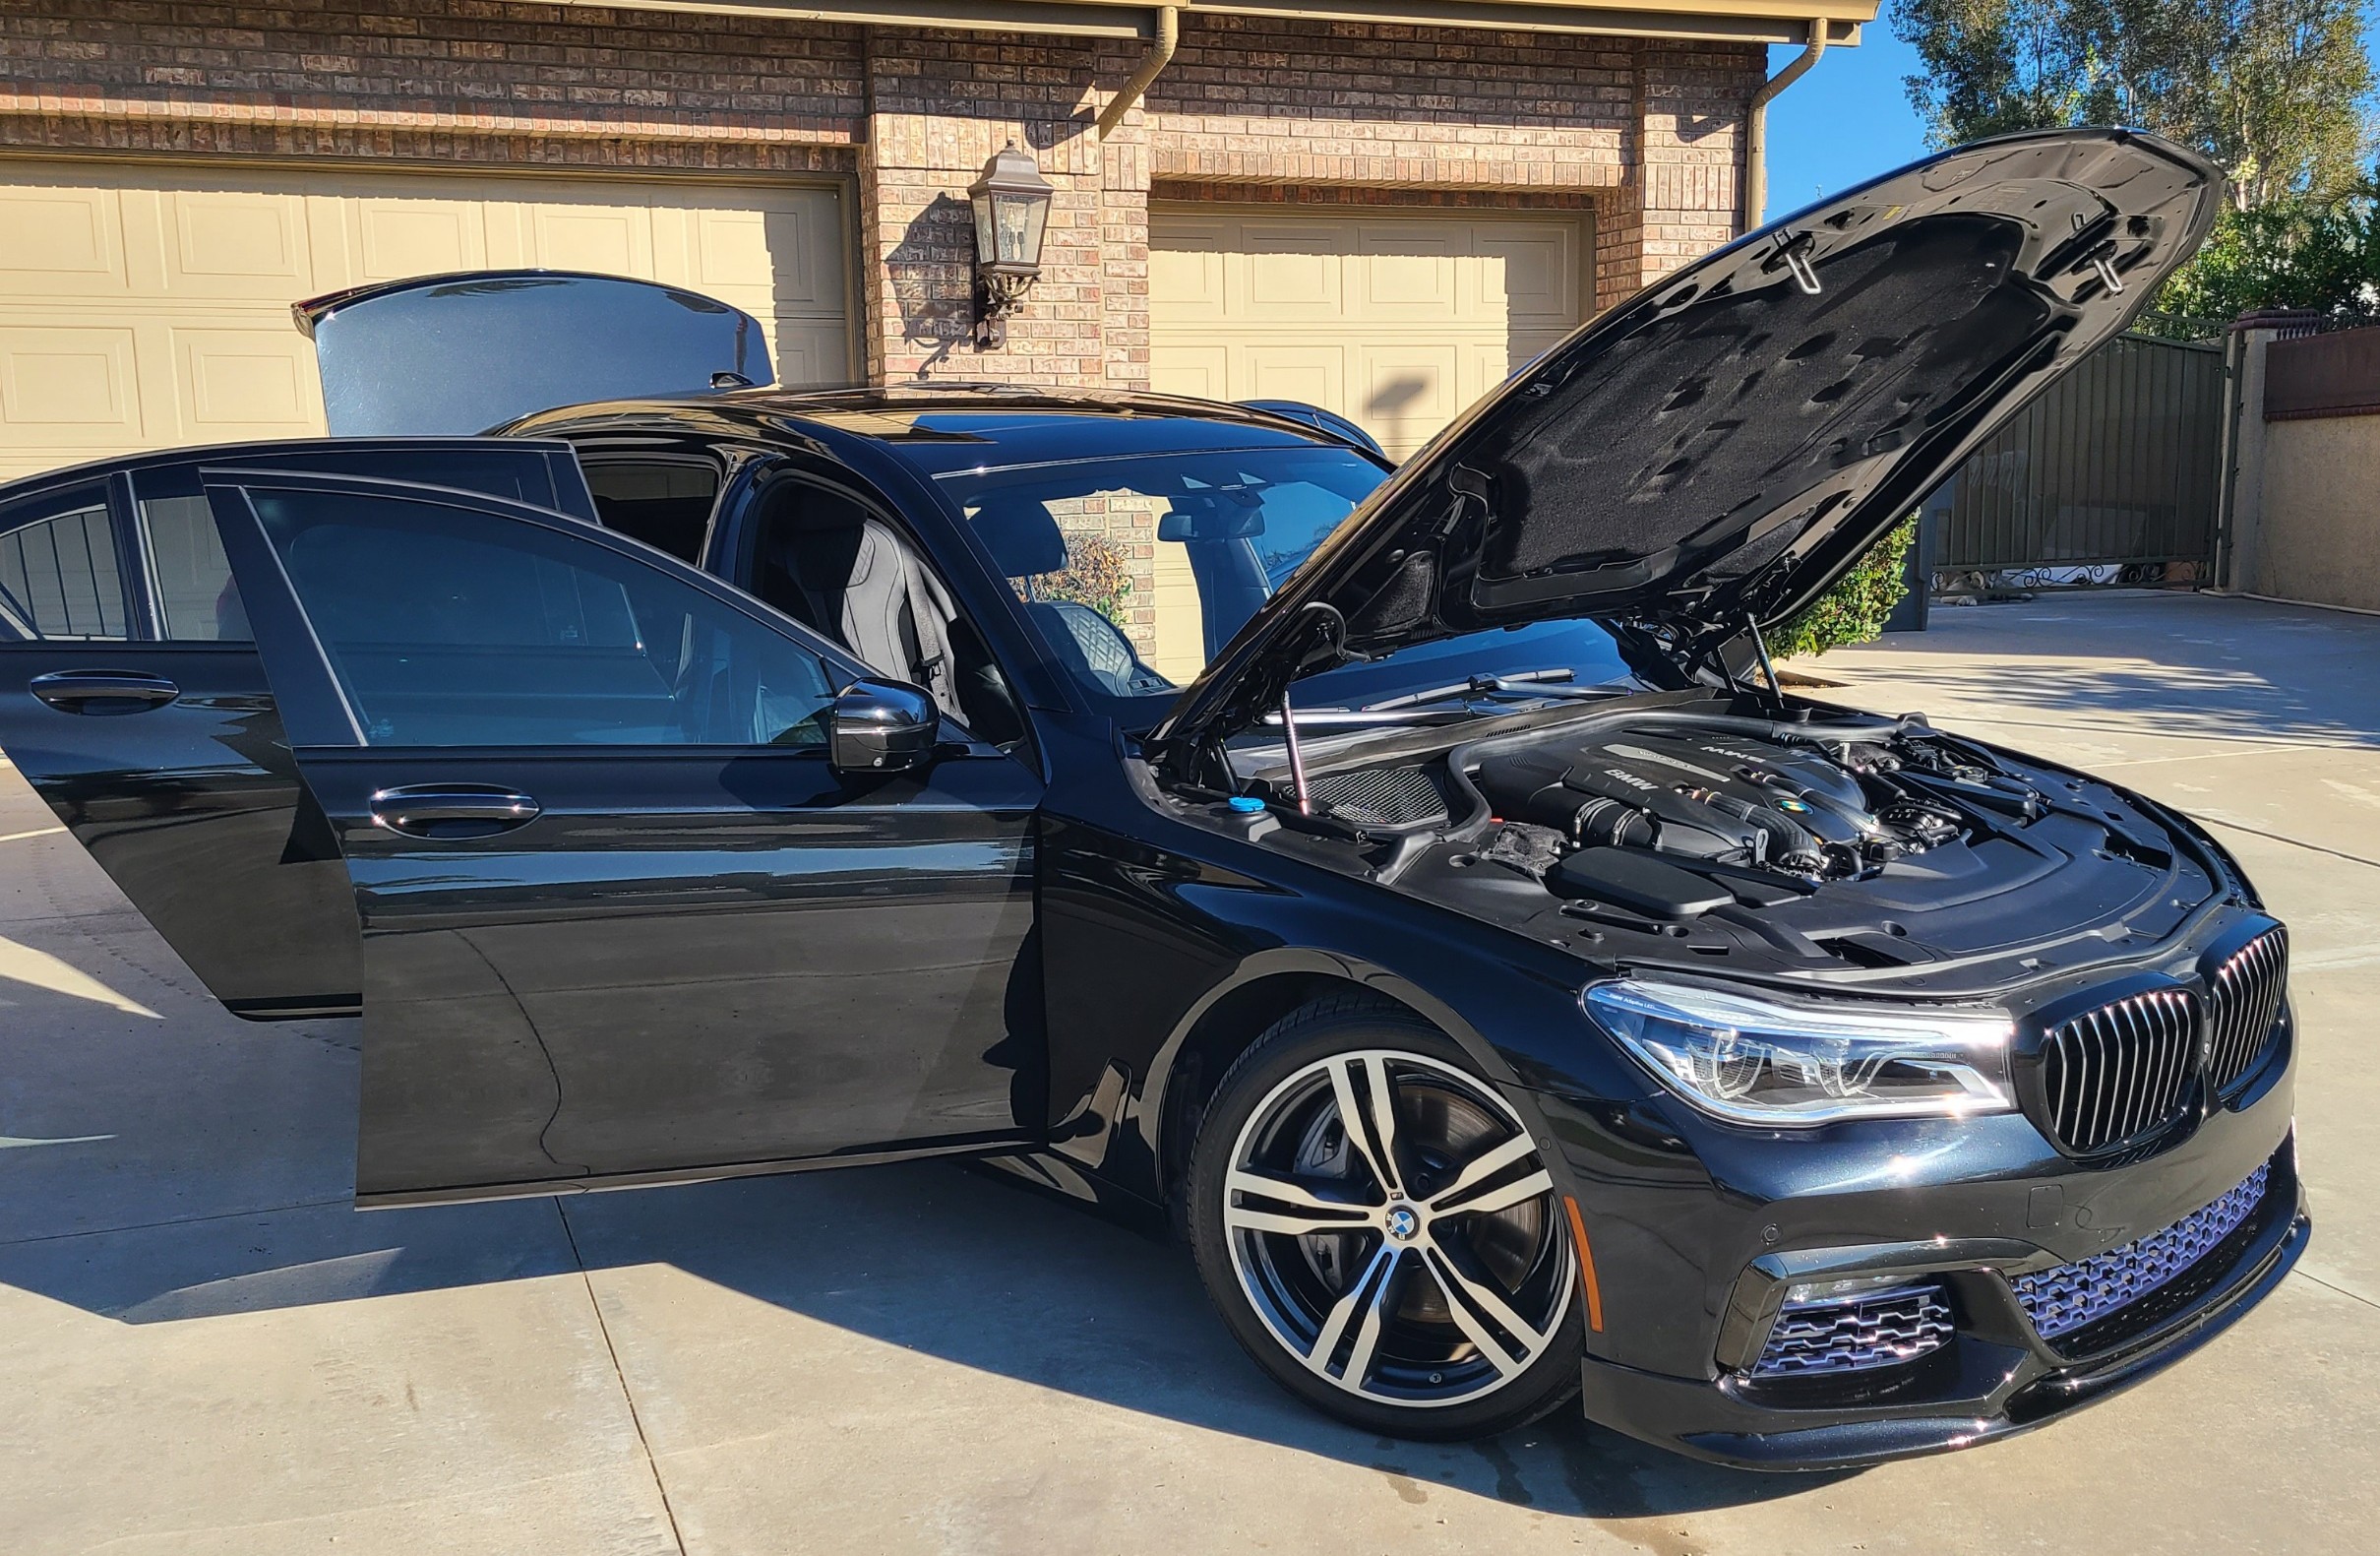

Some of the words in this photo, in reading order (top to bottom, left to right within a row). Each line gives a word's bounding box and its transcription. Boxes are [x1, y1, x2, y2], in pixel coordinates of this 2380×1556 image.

[1700, 746, 1767, 764] BMW
[1603, 769, 1660, 791] BMW
[1385, 1213, 1406, 1241] BMW
